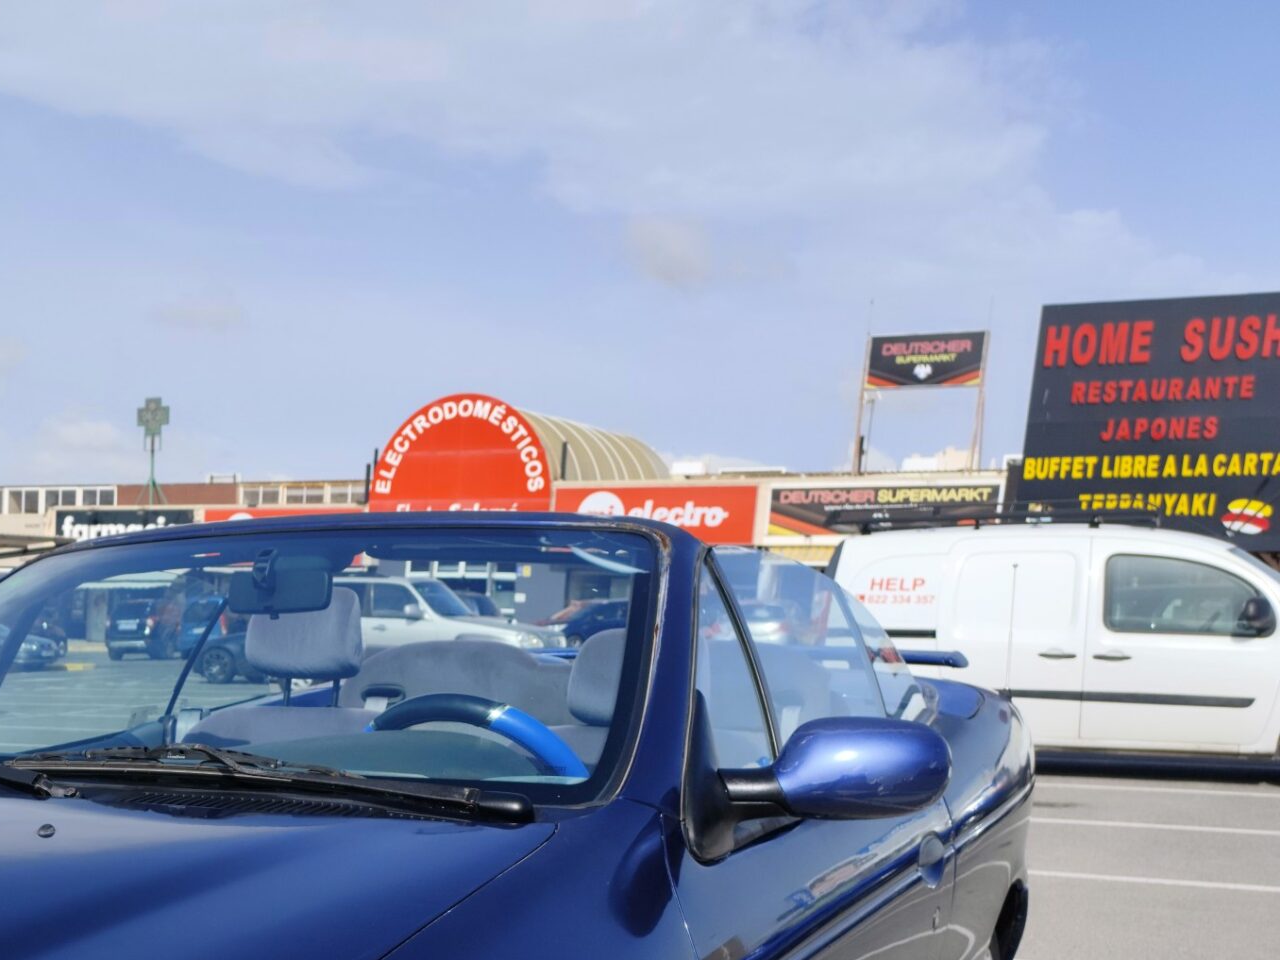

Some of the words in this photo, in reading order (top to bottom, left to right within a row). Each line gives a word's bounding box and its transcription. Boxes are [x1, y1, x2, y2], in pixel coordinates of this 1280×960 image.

[882, 339, 972, 356] DEUTSCHER
[1043, 320, 1154, 367] HOME
[895, 353, 958, 365] SUPERMARKT
[1071, 375, 1255, 405] RESTAURANTE
[1100, 416, 1219, 441] JAPONES
[375, 399, 544, 494] ELECTRODOMÉSTICOS
[1023, 456, 1098, 480] BUFFET
[1101, 455, 1160, 479] LIBRE
[1162, 454, 1178, 478] A
[1181, 453, 1209, 477] LA
[1213, 452, 1280, 477] CARTA
[779, 489, 874, 505] DEUTSCHER
[877, 487, 992, 503] SUPERMARKT
[62, 515, 176, 541] farm
[870, 578, 926, 591] HELP
